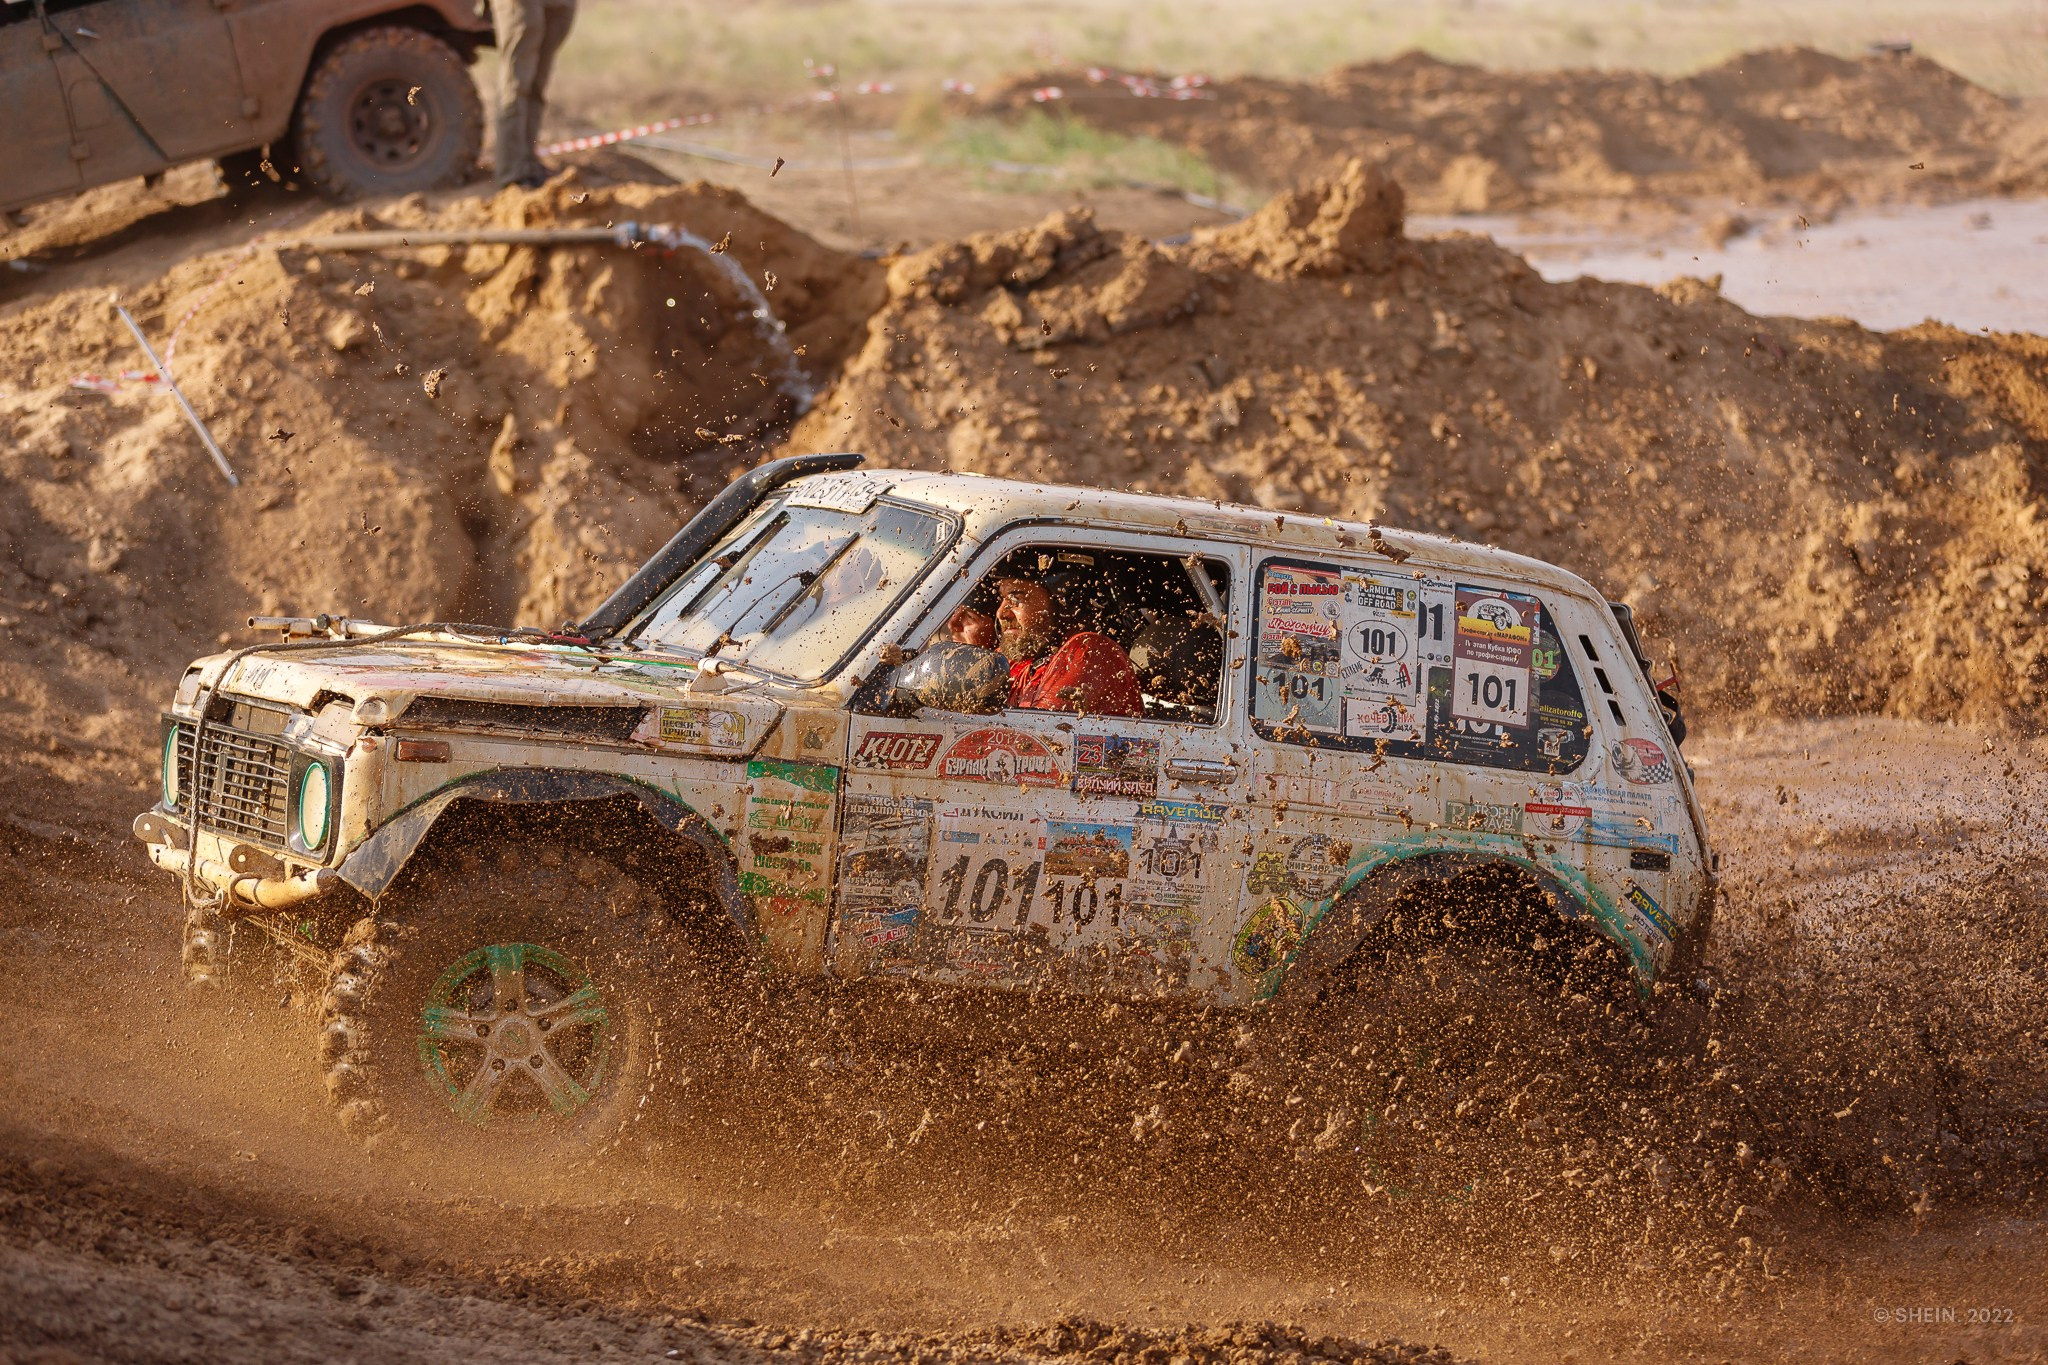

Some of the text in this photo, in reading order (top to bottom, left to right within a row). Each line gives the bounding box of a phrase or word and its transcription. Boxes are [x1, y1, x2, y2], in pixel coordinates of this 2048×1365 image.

[1267, 582, 1289, 595] БОЙ
[1299, 584, 1339, 596] ПЫЛЬЮ
[1358, 596, 1396, 610] OFF ROAD
[1360, 628, 1396, 656] 101
[1473, 641, 1487, 649] этап
[1487, 643, 1506, 653] Кубка
[1506, 646, 1522, 655] ЮФО
[1272, 672, 1325, 702] 101
[1467, 672, 1517, 711] 101
[862, 737, 937, 763] KLOTZ
[1078, 743, 1102, 764] 23
[1626, 790, 1652, 801] ПАЛАТА
[1142, 804, 1222, 820] RAVENOL
[1475, 804, 1522, 820] TROPHY
[1140, 850, 1201, 879] 101
[938, 855, 1042, 926] 101
[1041, 879, 1123, 927] 101
